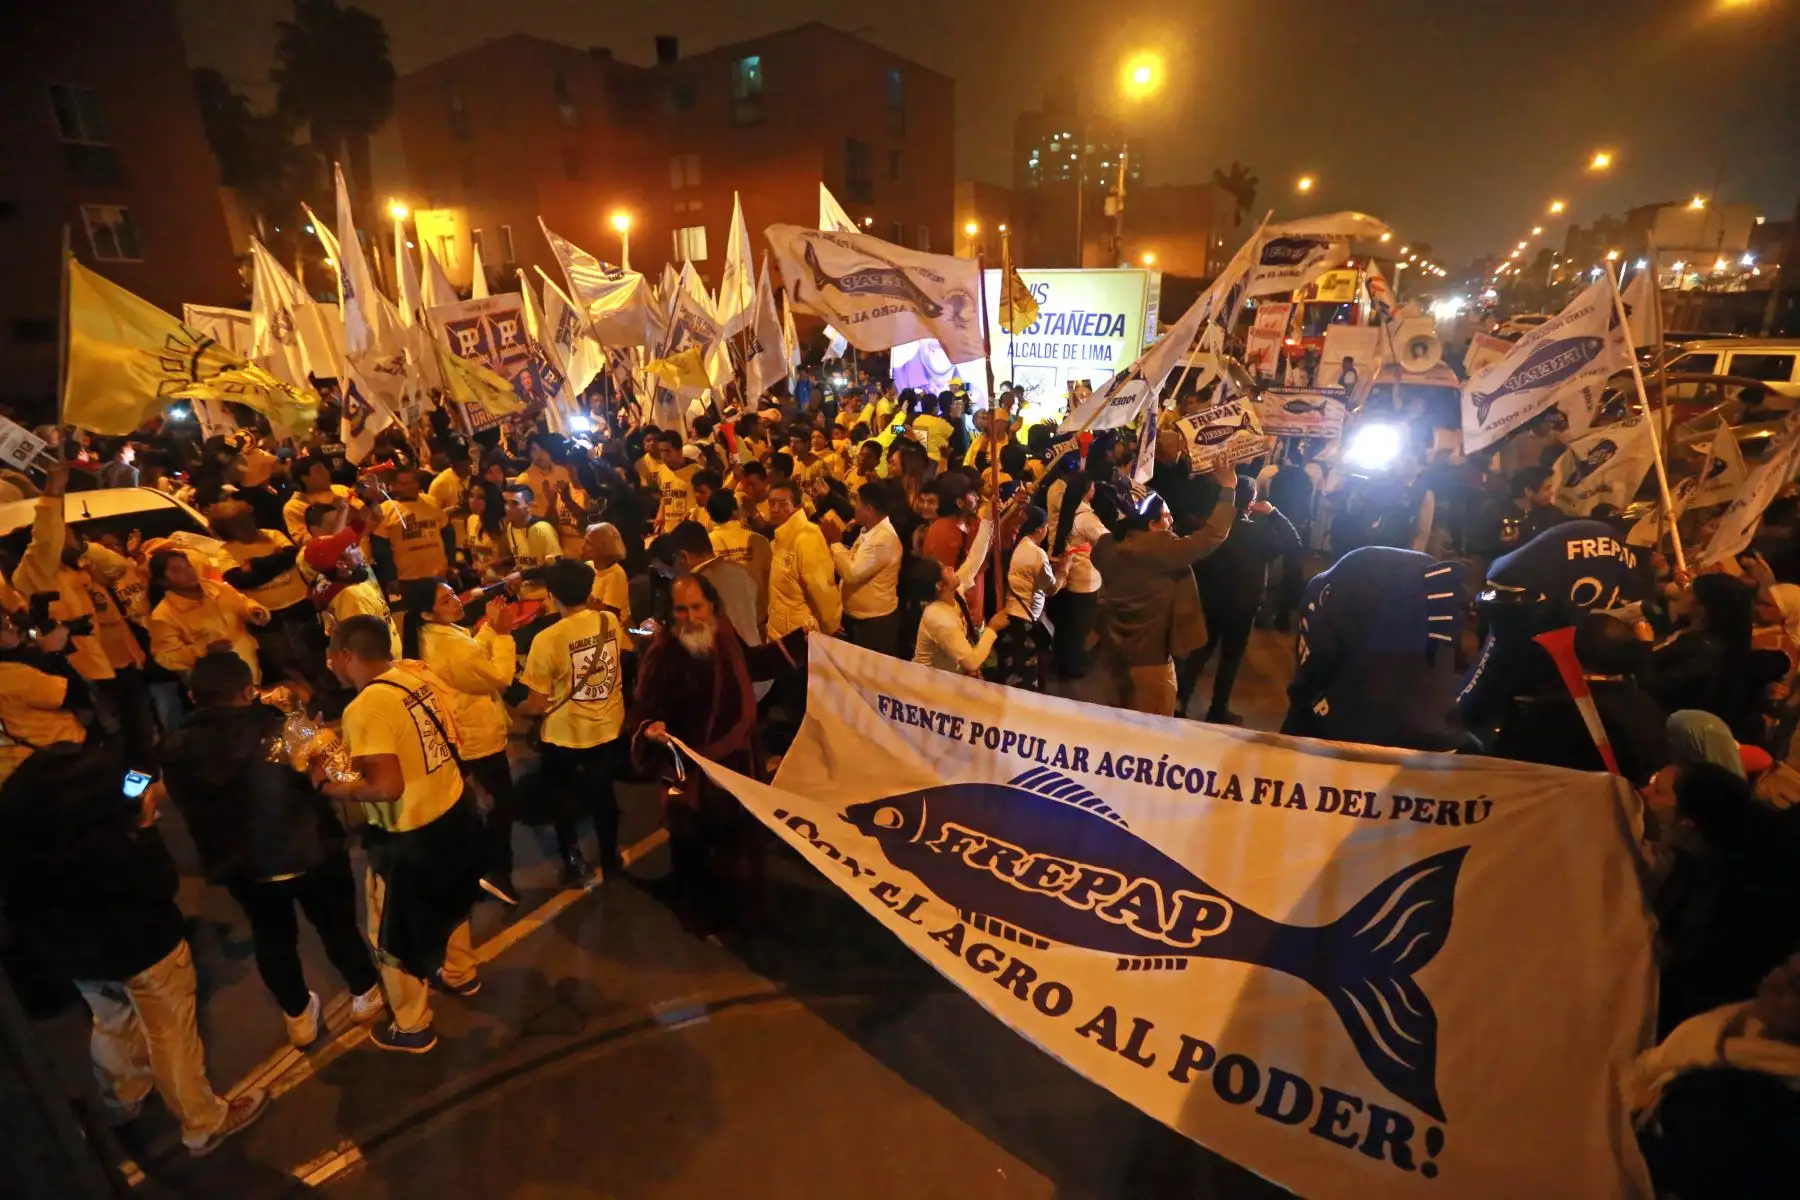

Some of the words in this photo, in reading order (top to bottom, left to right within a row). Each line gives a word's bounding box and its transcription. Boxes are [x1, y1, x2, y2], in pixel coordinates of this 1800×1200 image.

[1001, 310, 1126, 338] STAÑEDA
[1007, 341, 1059, 360] ALCALDE
[1062, 343, 1078, 360] DE
[1082, 344, 1112, 362] LIMA
[877, 693, 964, 740] FRENTE
[970, 721, 1090, 774] POPULAR
[1094, 751, 1244, 803] AGRÍCOLA
[1251, 777, 1307, 811] FIA
[1315, 785, 1382, 820] DEL
[1388, 794, 1494, 828] PERÚ
[925, 822, 1234, 948] FREPAP
[869, 881, 929, 925] EL
[927, 922, 1074, 1017] AGRO
[1075, 1005, 1157, 1069] AL
[1167, 1034, 1445, 1179] PODER!
